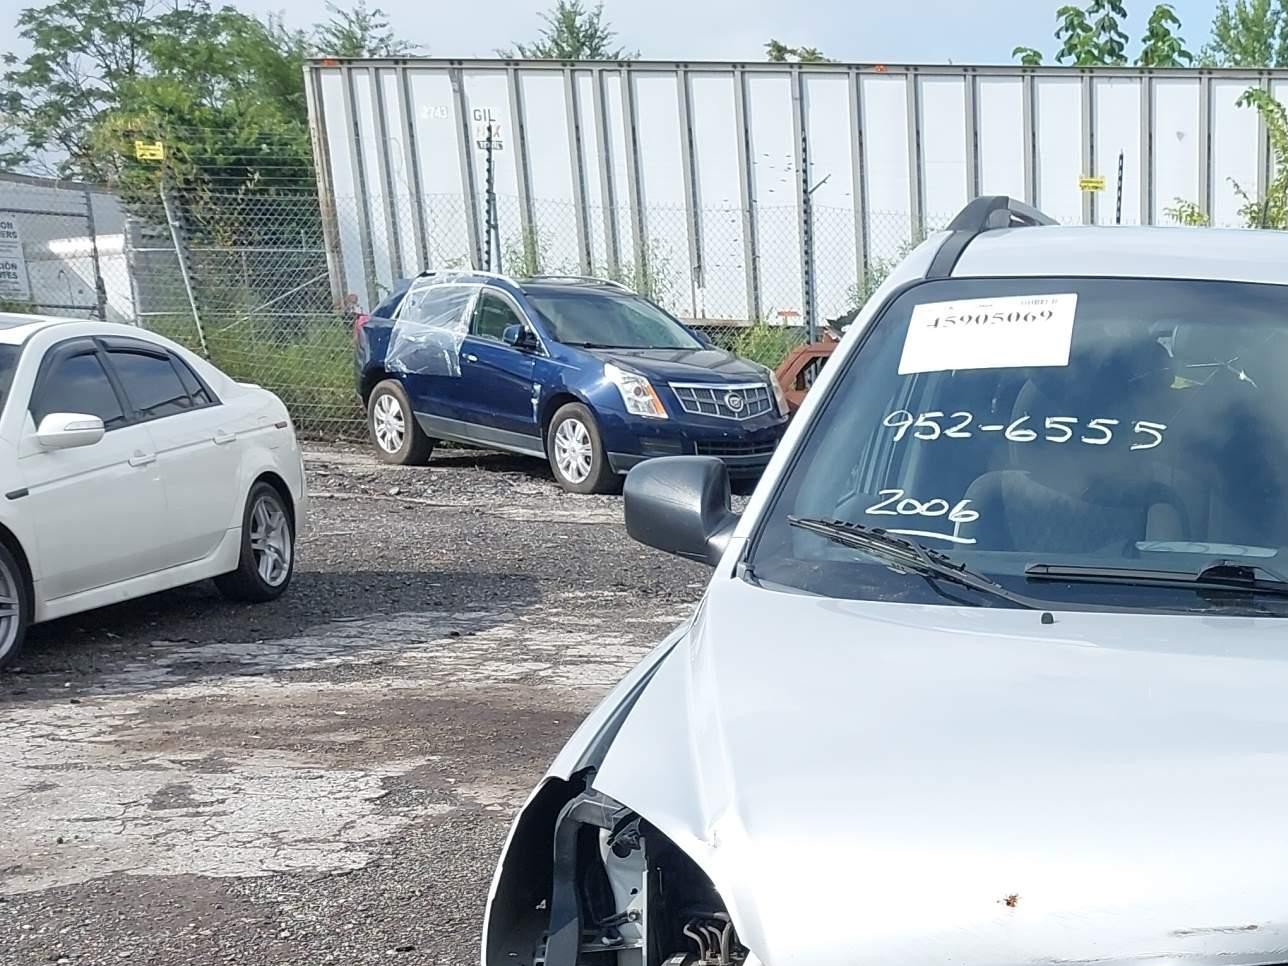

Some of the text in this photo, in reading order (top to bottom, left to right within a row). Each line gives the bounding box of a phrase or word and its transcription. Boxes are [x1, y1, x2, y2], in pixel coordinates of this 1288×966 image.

[926, 310, 1053, 328] 45905069
[883, 410, 1168, 451] 952-6555
[864, 488, 980, 523] 2006
